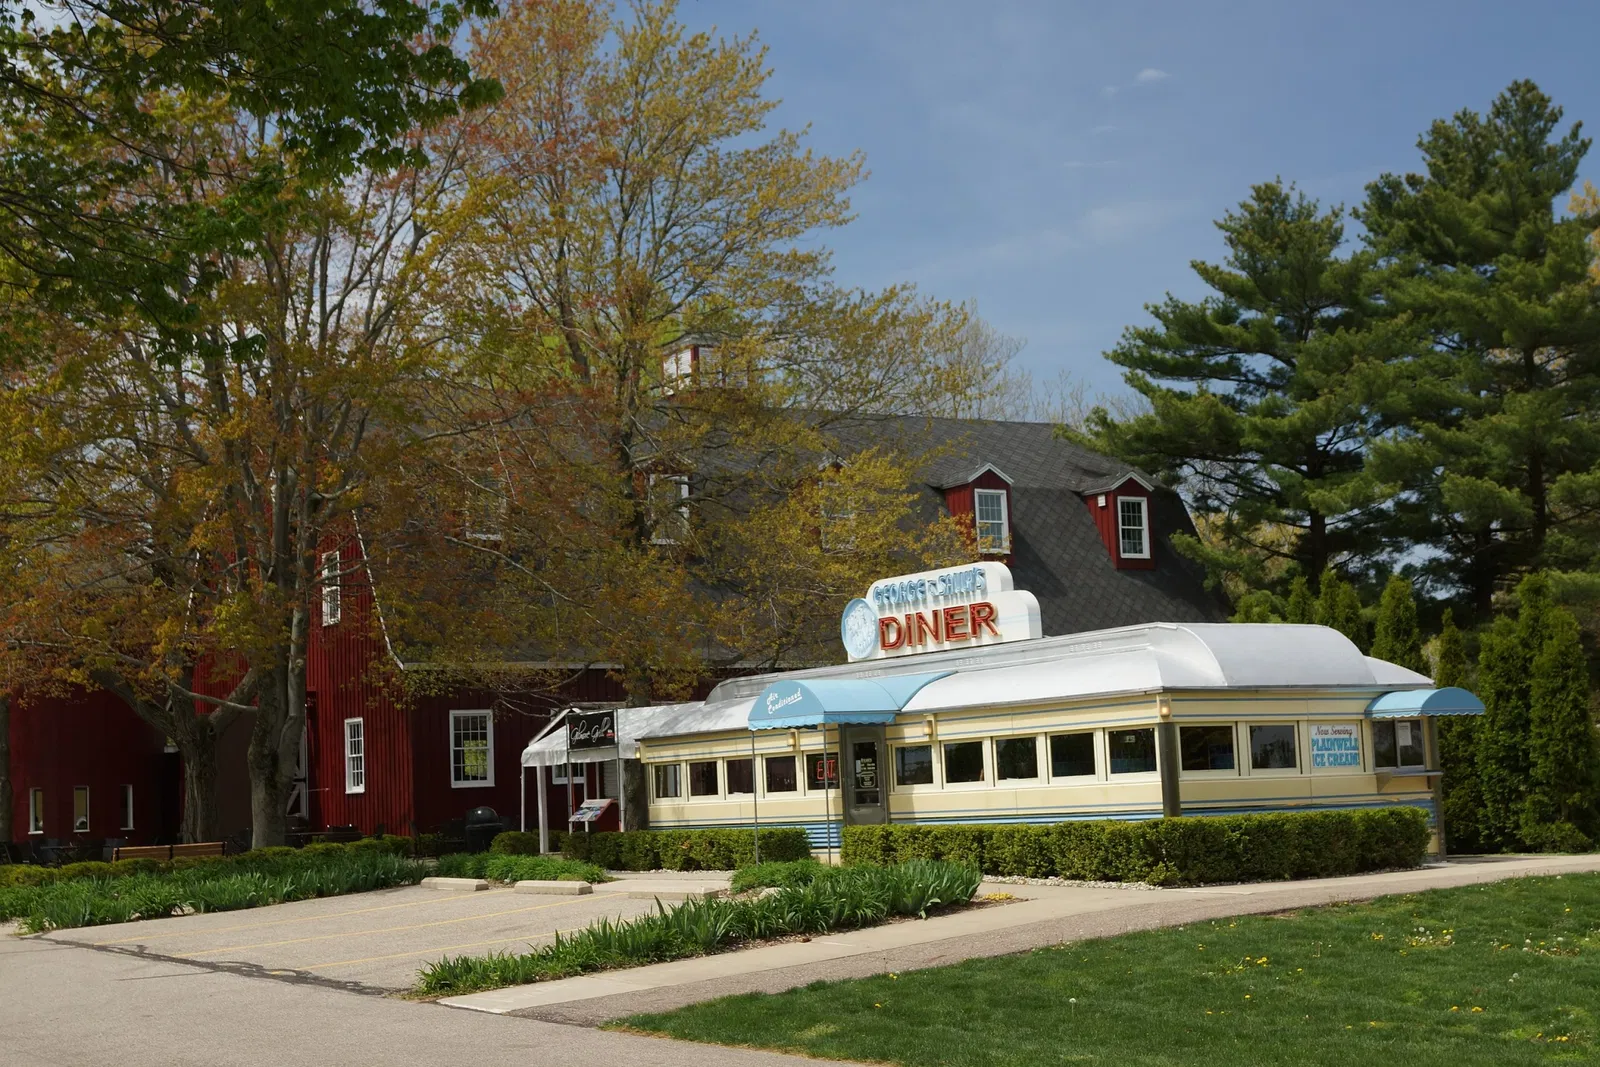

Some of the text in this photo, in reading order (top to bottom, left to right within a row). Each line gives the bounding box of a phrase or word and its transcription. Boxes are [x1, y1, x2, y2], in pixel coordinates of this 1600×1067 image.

[873, 579, 926, 605] GEORGE
[878, 601, 1001, 650] DINER
[767, 692, 778, 706] Air
[768, 687, 802, 714] Conditioned
[1315, 725, 1353, 739] Now Serving
[1312, 753, 1326, 767] ICE
